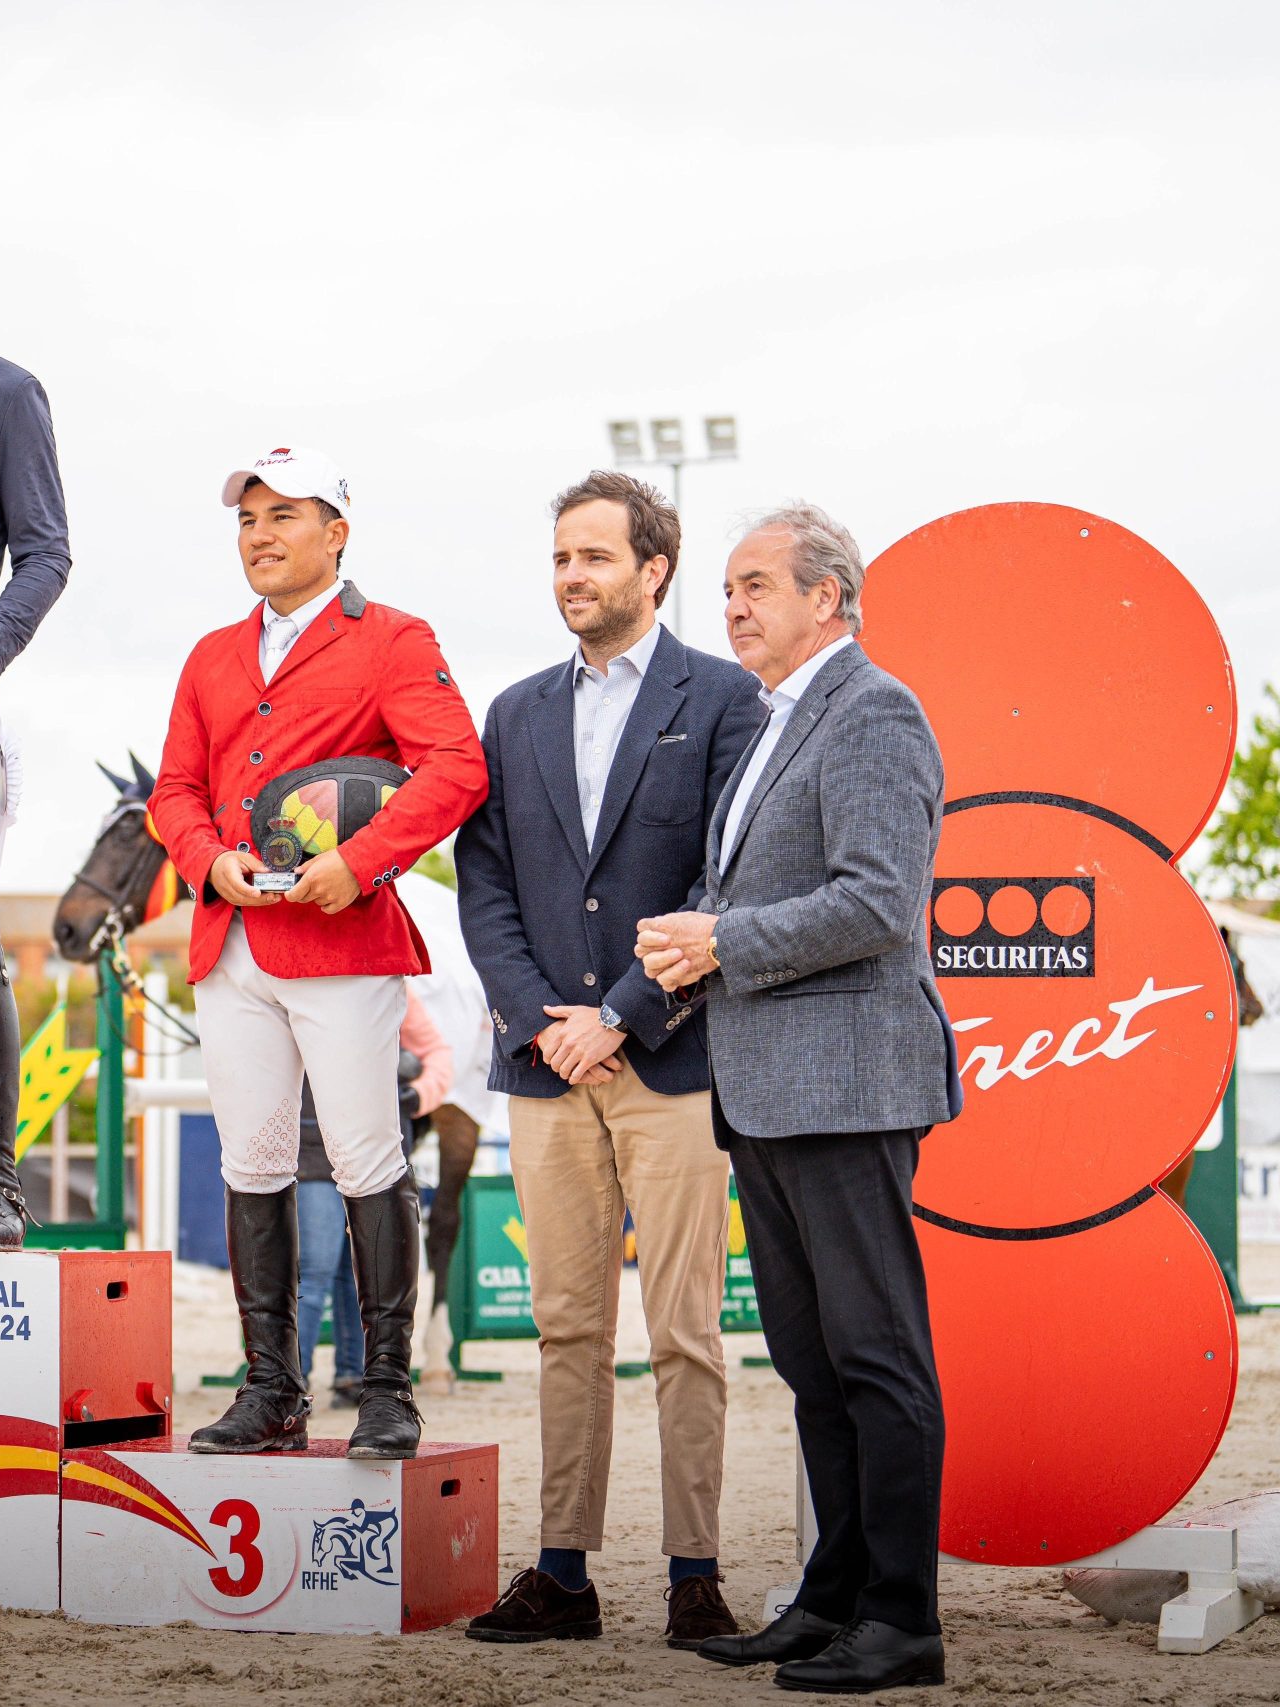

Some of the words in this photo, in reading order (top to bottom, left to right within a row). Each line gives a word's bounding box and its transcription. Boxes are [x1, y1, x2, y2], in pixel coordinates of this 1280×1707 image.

[936, 945, 1088, 970] SECURITAS
[951, 976, 1205, 1091] rect
[207, 1499, 264, 1598] 3
[301, 1570, 338, 1591] RFHE
